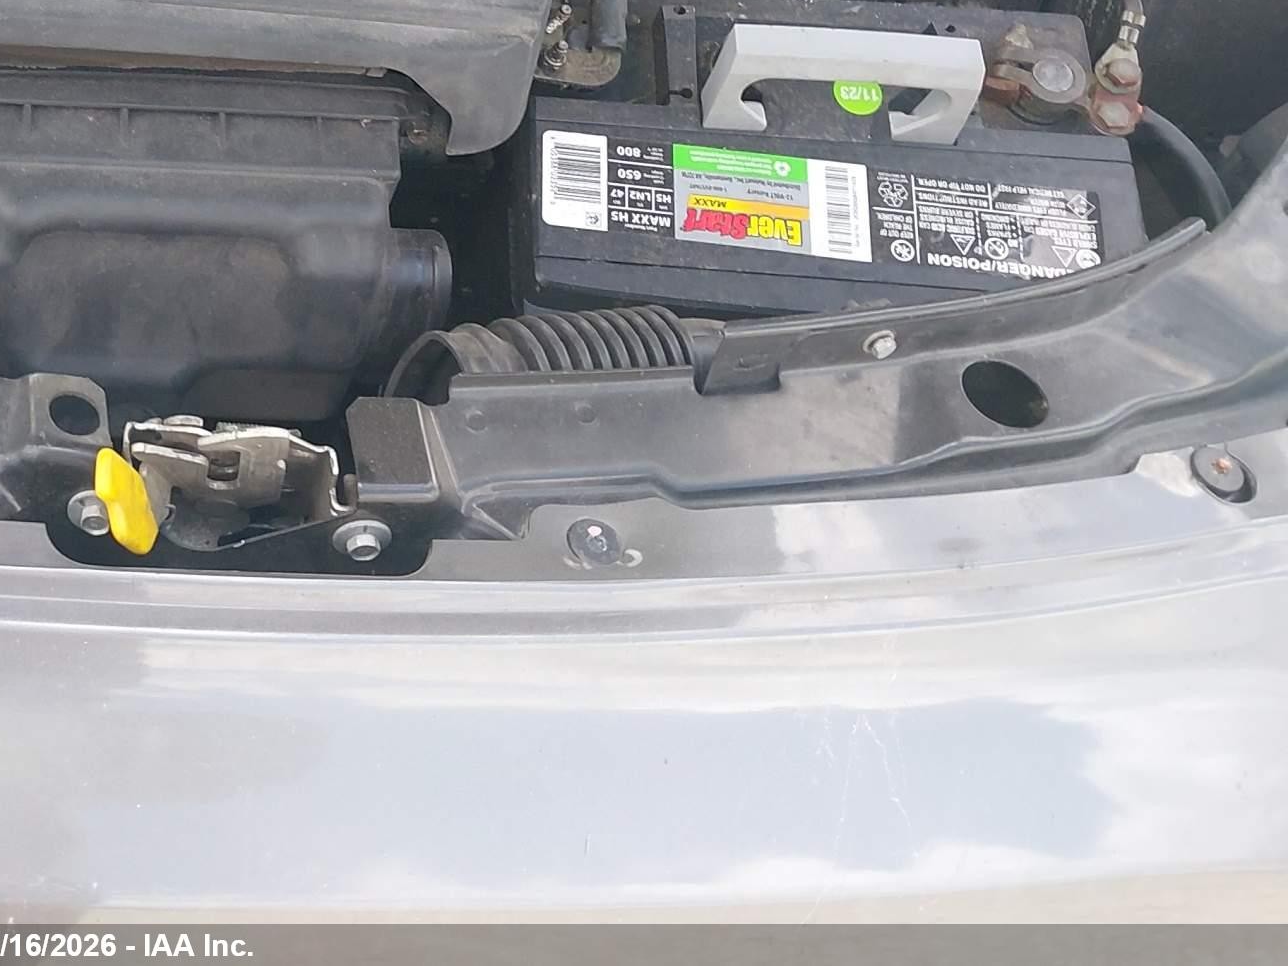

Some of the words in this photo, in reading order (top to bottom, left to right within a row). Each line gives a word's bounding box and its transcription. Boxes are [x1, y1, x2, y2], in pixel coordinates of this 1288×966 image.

[840, 86, 880, 102] 11/23
[616, 146, 642, 158] 800
[617, 168, 642, 180] 650
[610, 189, 624, 198] 47
[629, 190, 651, 201] LN2
[694, 198, 727, 209] MAXX
[632, 213, 671, 227] MAXX
[683, 208, 803, 247] EverStart
[927, 253, 1066, 278] DANGER/POISON
